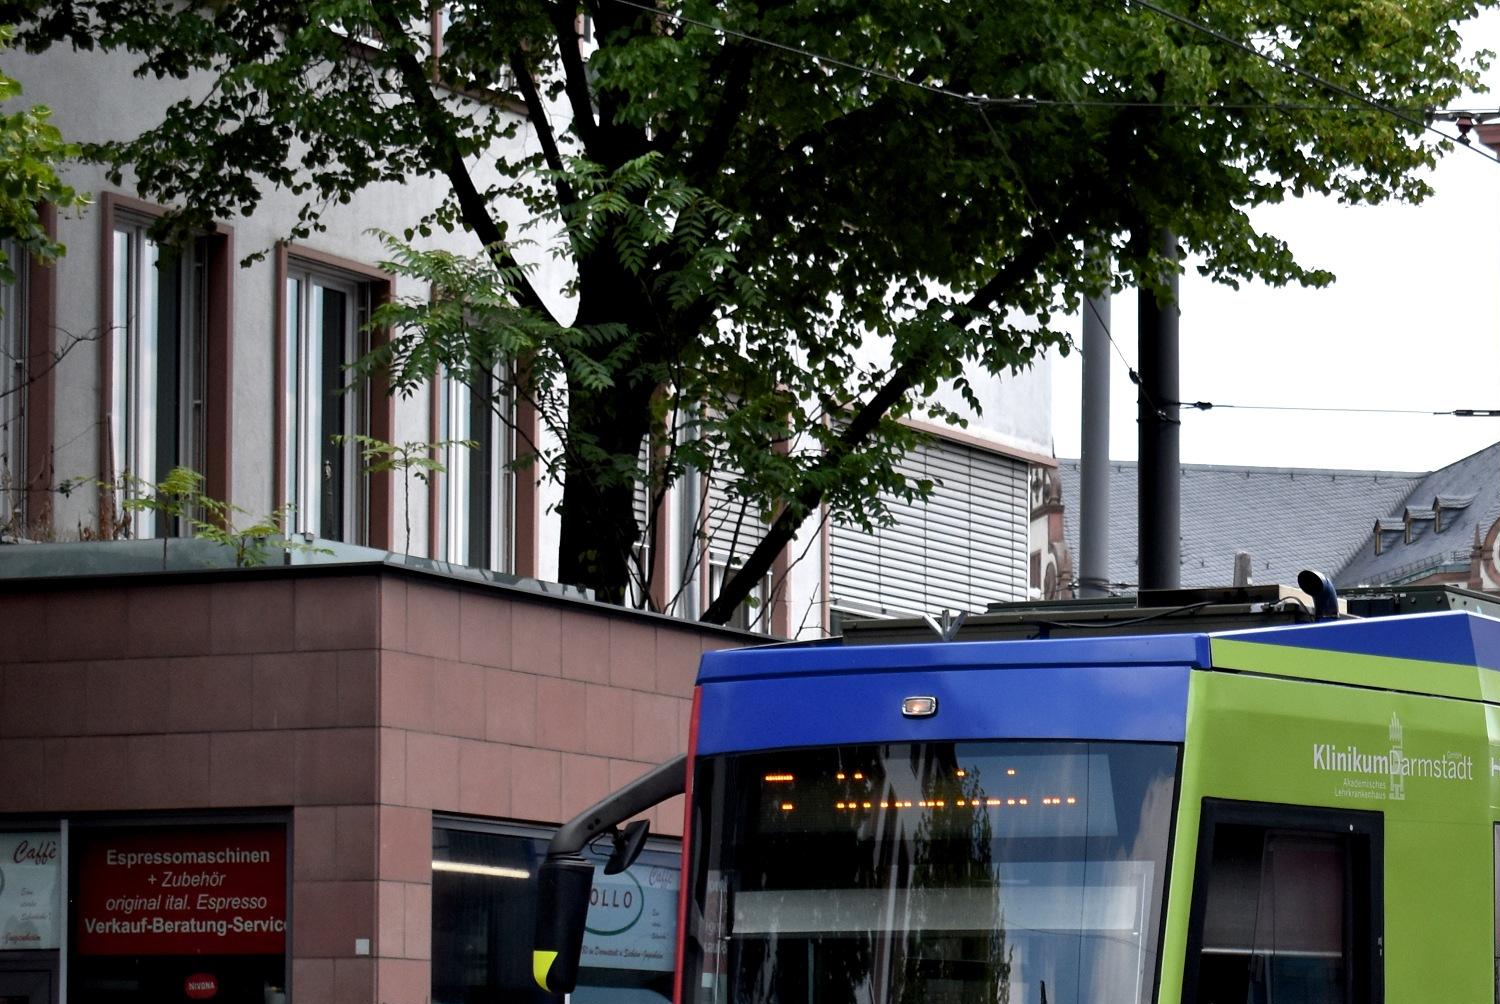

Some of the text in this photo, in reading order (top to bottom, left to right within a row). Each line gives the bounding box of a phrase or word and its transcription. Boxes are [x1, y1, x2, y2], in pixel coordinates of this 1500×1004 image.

[1343, 778, 1386, 789] Akademisches
[1334, 787, 1386, 799] Lehrkrankenhaus
[107, 847, 270, 868] Espressomaschinen
[148, 871, 226, 888] + Zubehör
[106, 893, 267, 914] original ital. Espresso
[590, 889, 632, 908] OLLO
